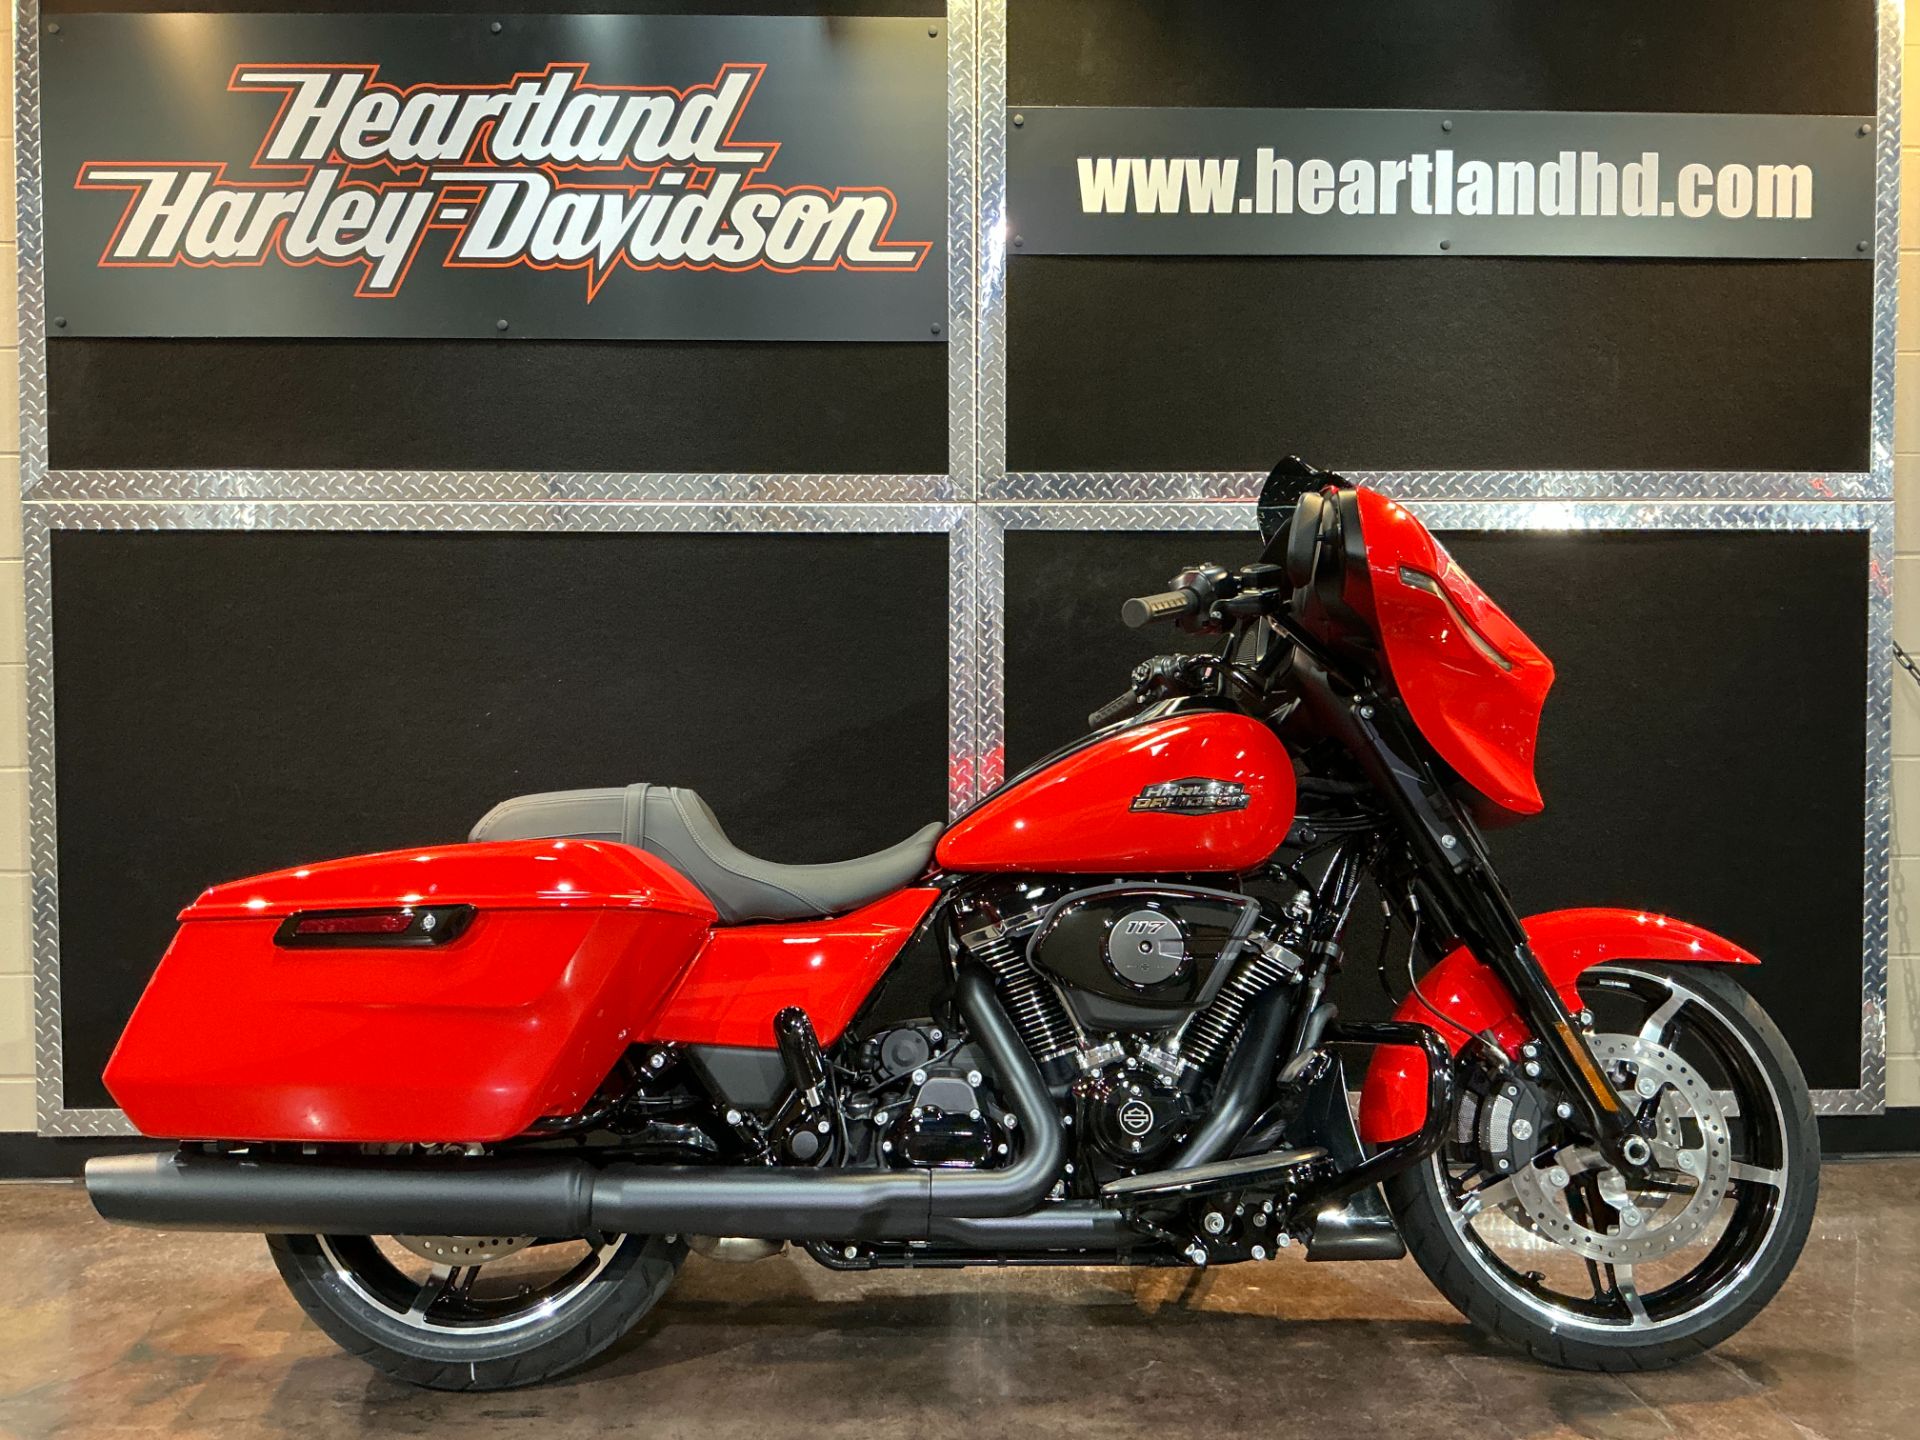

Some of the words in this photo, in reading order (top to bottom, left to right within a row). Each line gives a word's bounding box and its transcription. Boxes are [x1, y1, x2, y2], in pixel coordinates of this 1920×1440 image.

[238, 69, 765, 164] Heartland
[1076, 147, 1813, 220] www.heartlandhd.com
[86, 167, 919, 289] Harley-Davidson
[1125, 920, 1168, 934] 117
